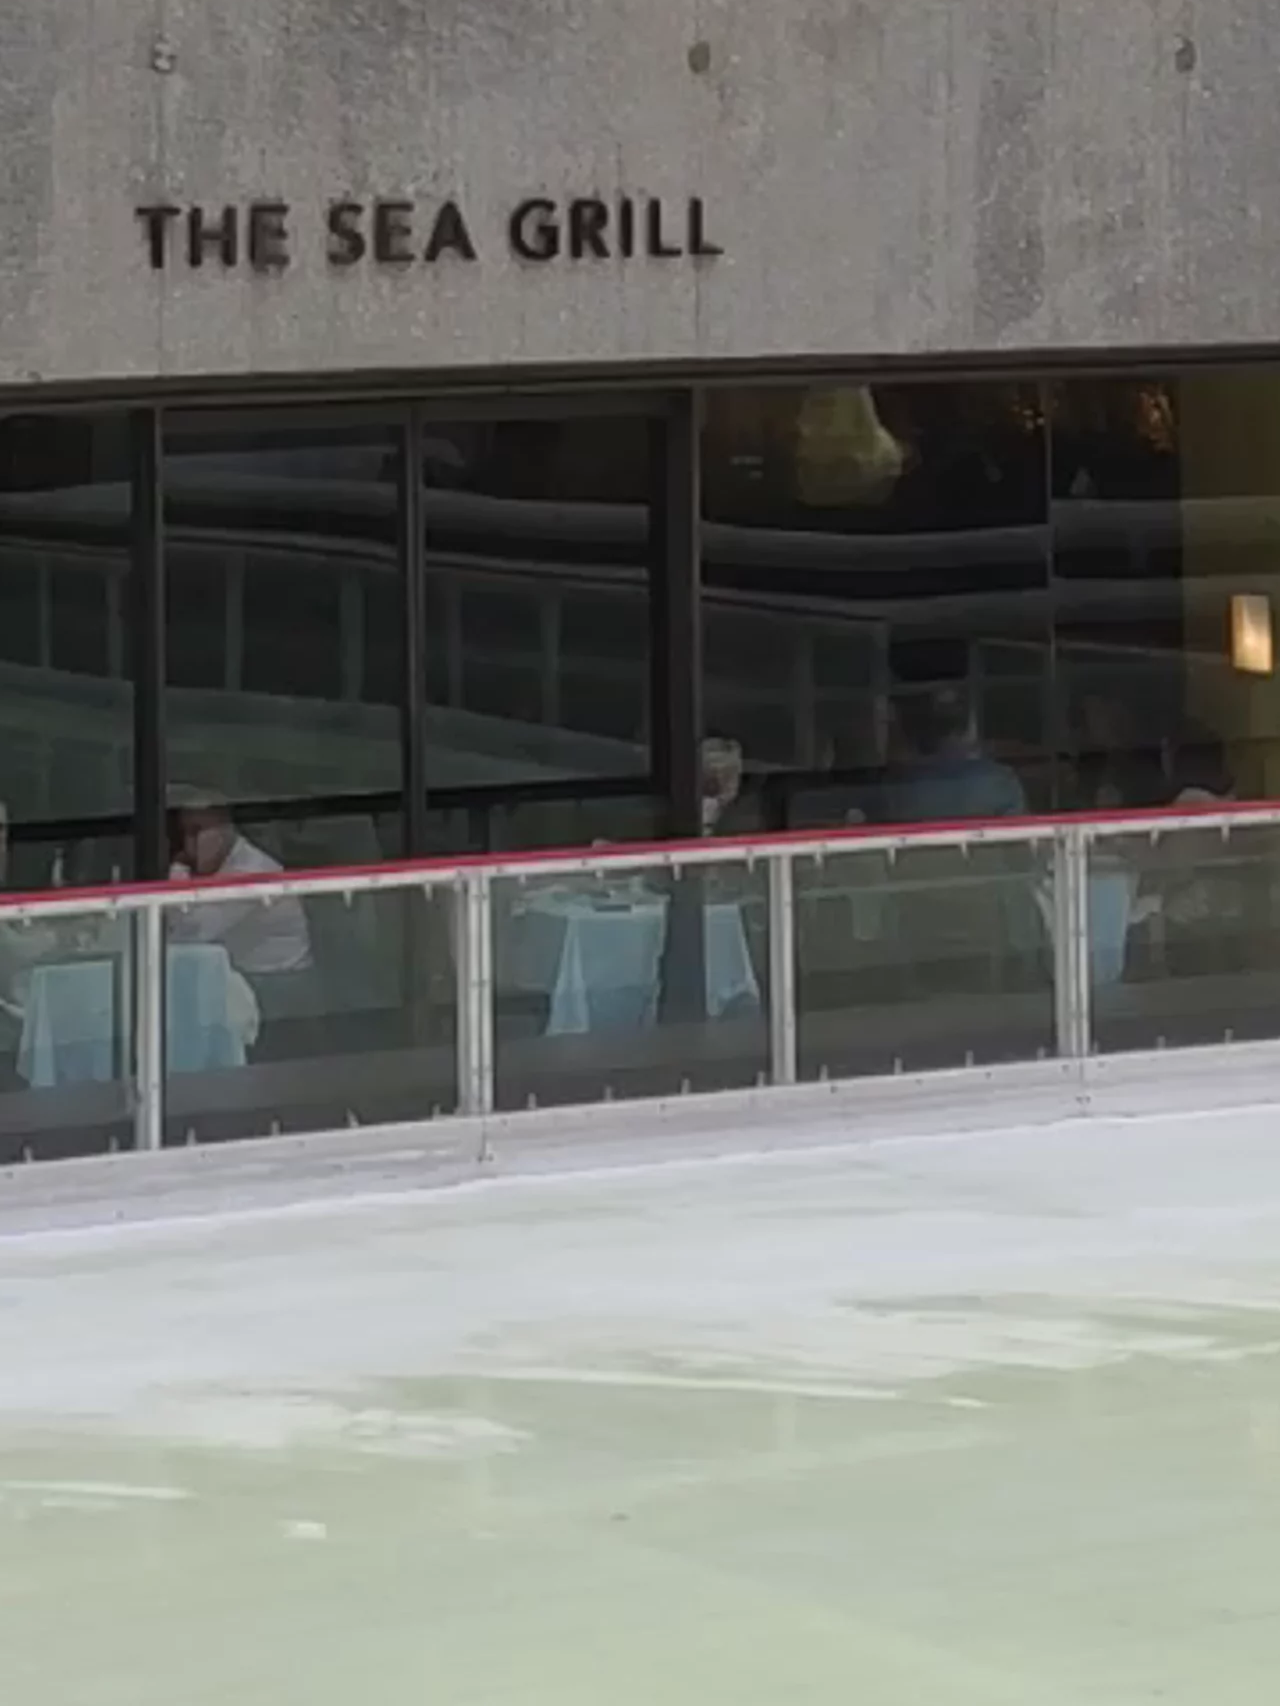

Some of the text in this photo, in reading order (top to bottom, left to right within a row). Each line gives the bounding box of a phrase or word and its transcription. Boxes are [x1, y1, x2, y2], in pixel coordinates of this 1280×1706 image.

[133, 196, 723, 272] THE SEA GRILL
